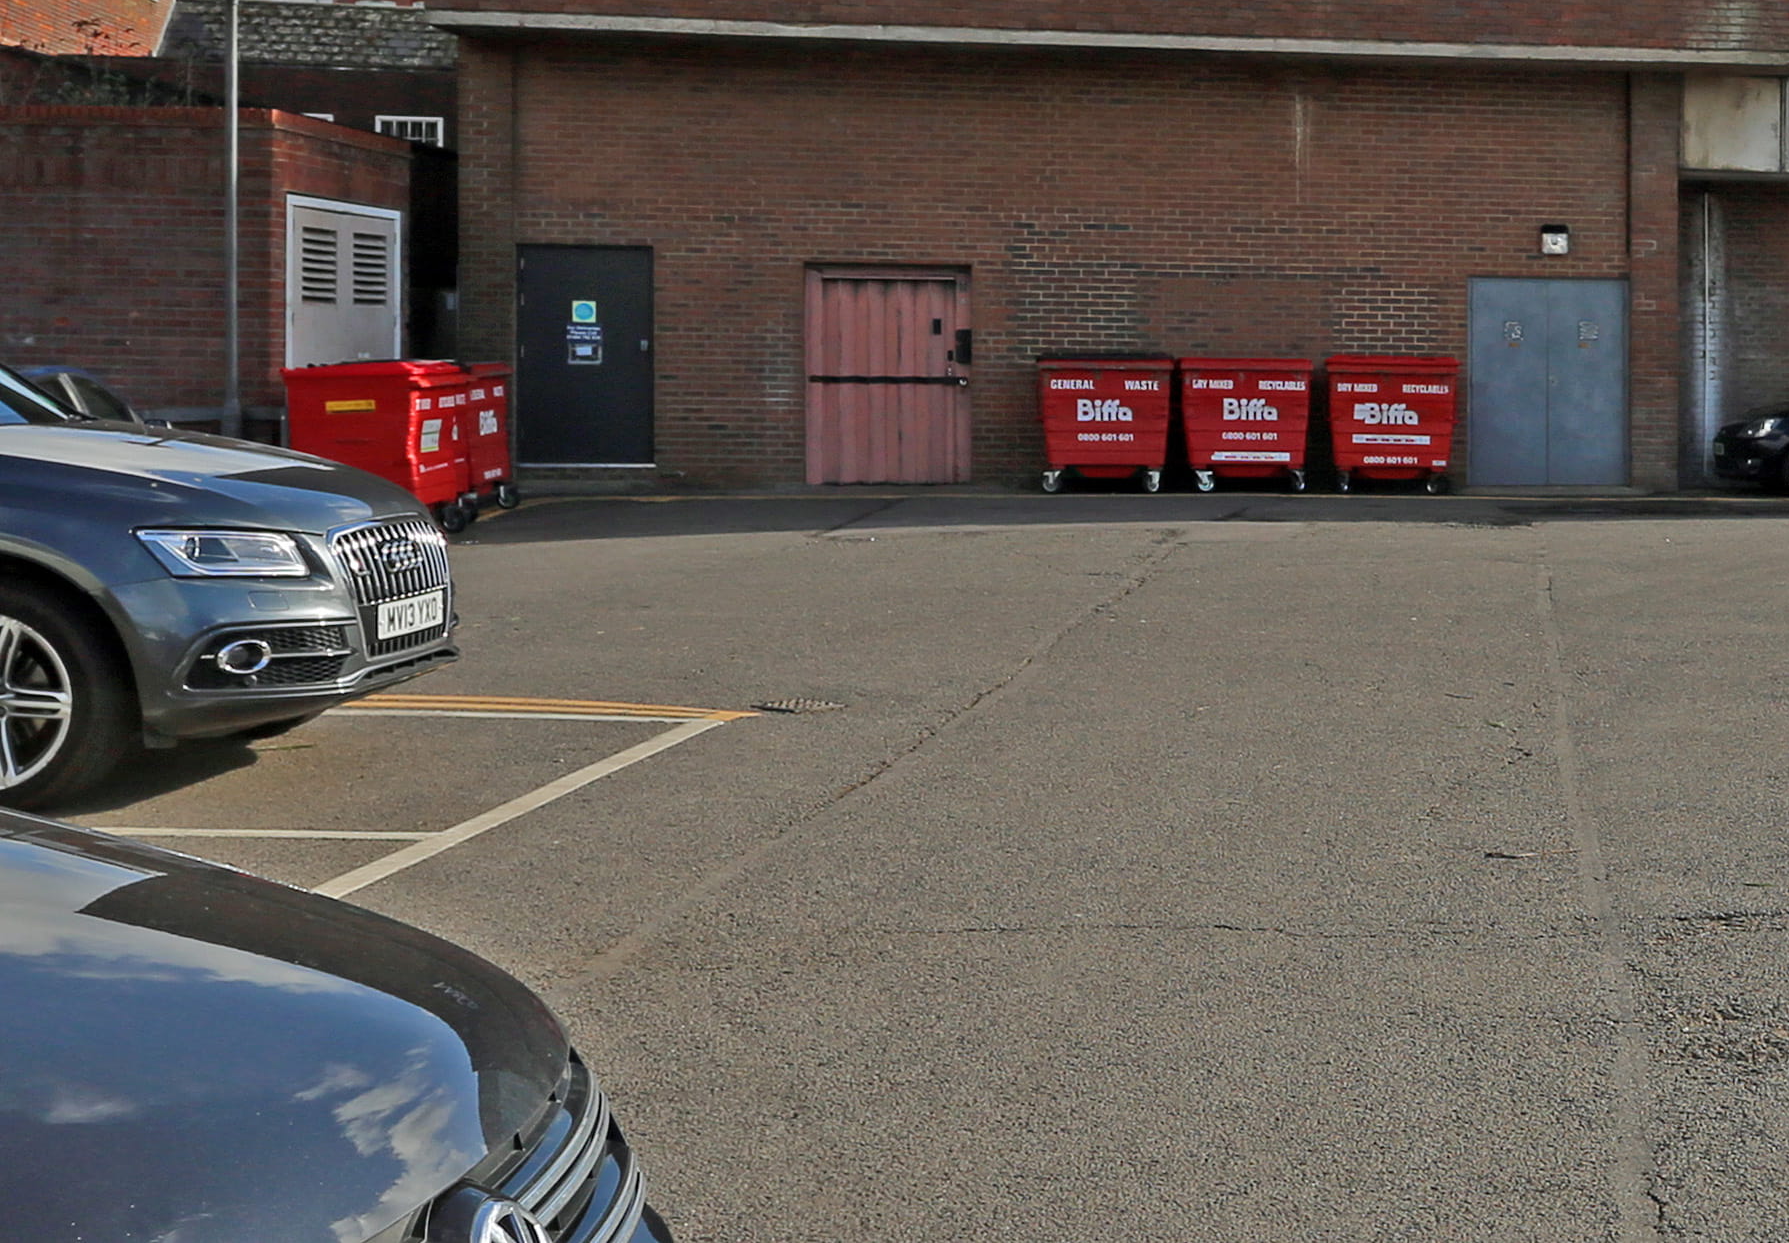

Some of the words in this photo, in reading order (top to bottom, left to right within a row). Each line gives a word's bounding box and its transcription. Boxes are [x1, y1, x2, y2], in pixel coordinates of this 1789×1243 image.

[1050, 379, 1095, 390] GENERAL
[1124, 380, 1159, 391] WASTE
[1258, 380, 1306, 391] RECYCLABLES
[1402, 384, 1449, 394] RECYCLABLES
[1077, 398, 1133, 422] Biffa
[1223, 397, 1278, 421] Biffa
[1364, 403, 1419, 425] Biffa
[387, 603, 415, 632] MV13
